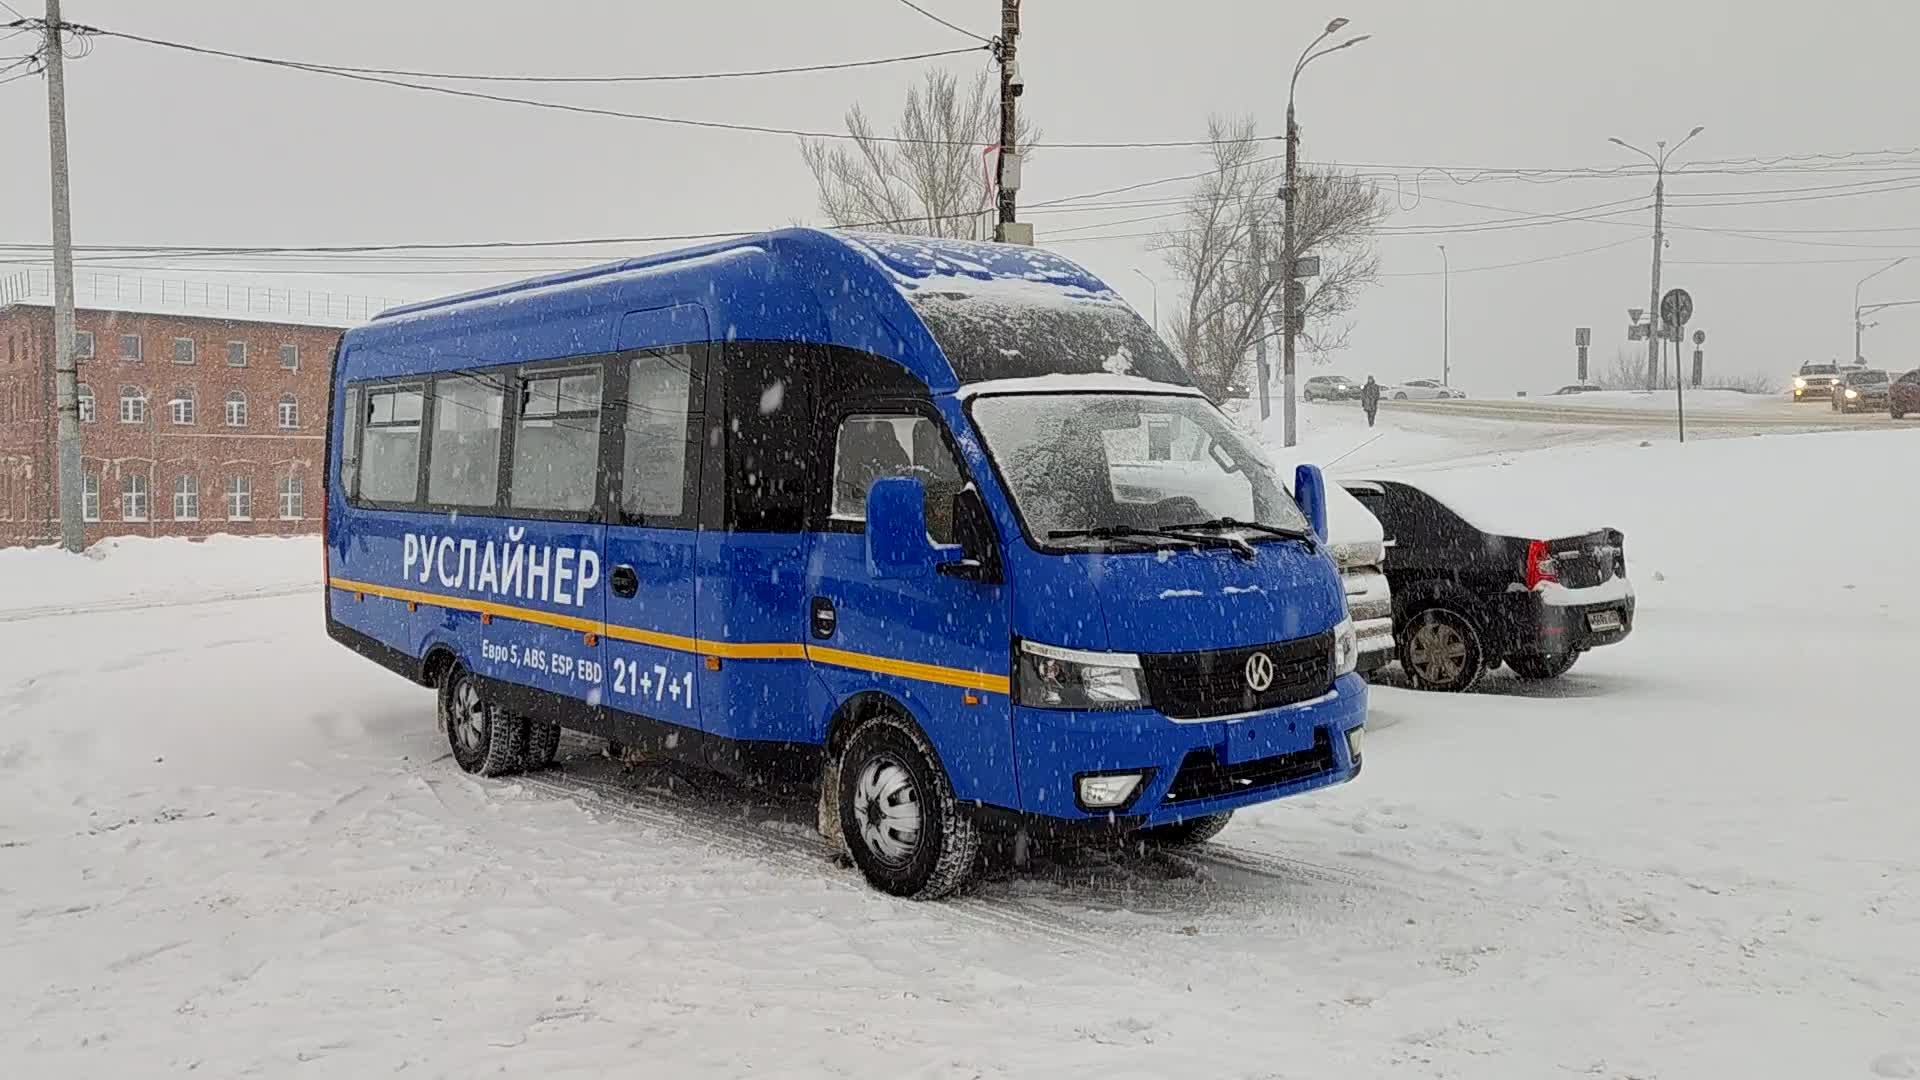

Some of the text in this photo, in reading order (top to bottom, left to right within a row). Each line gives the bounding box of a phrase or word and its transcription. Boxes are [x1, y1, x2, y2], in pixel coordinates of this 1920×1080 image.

[403, 526, 600, 607] РУСЛАЙНЕР
[481, 639, 603, 684] Евро 5, ABS, ESP, EBD
[613, 657, 693, 709] 21+7+1
